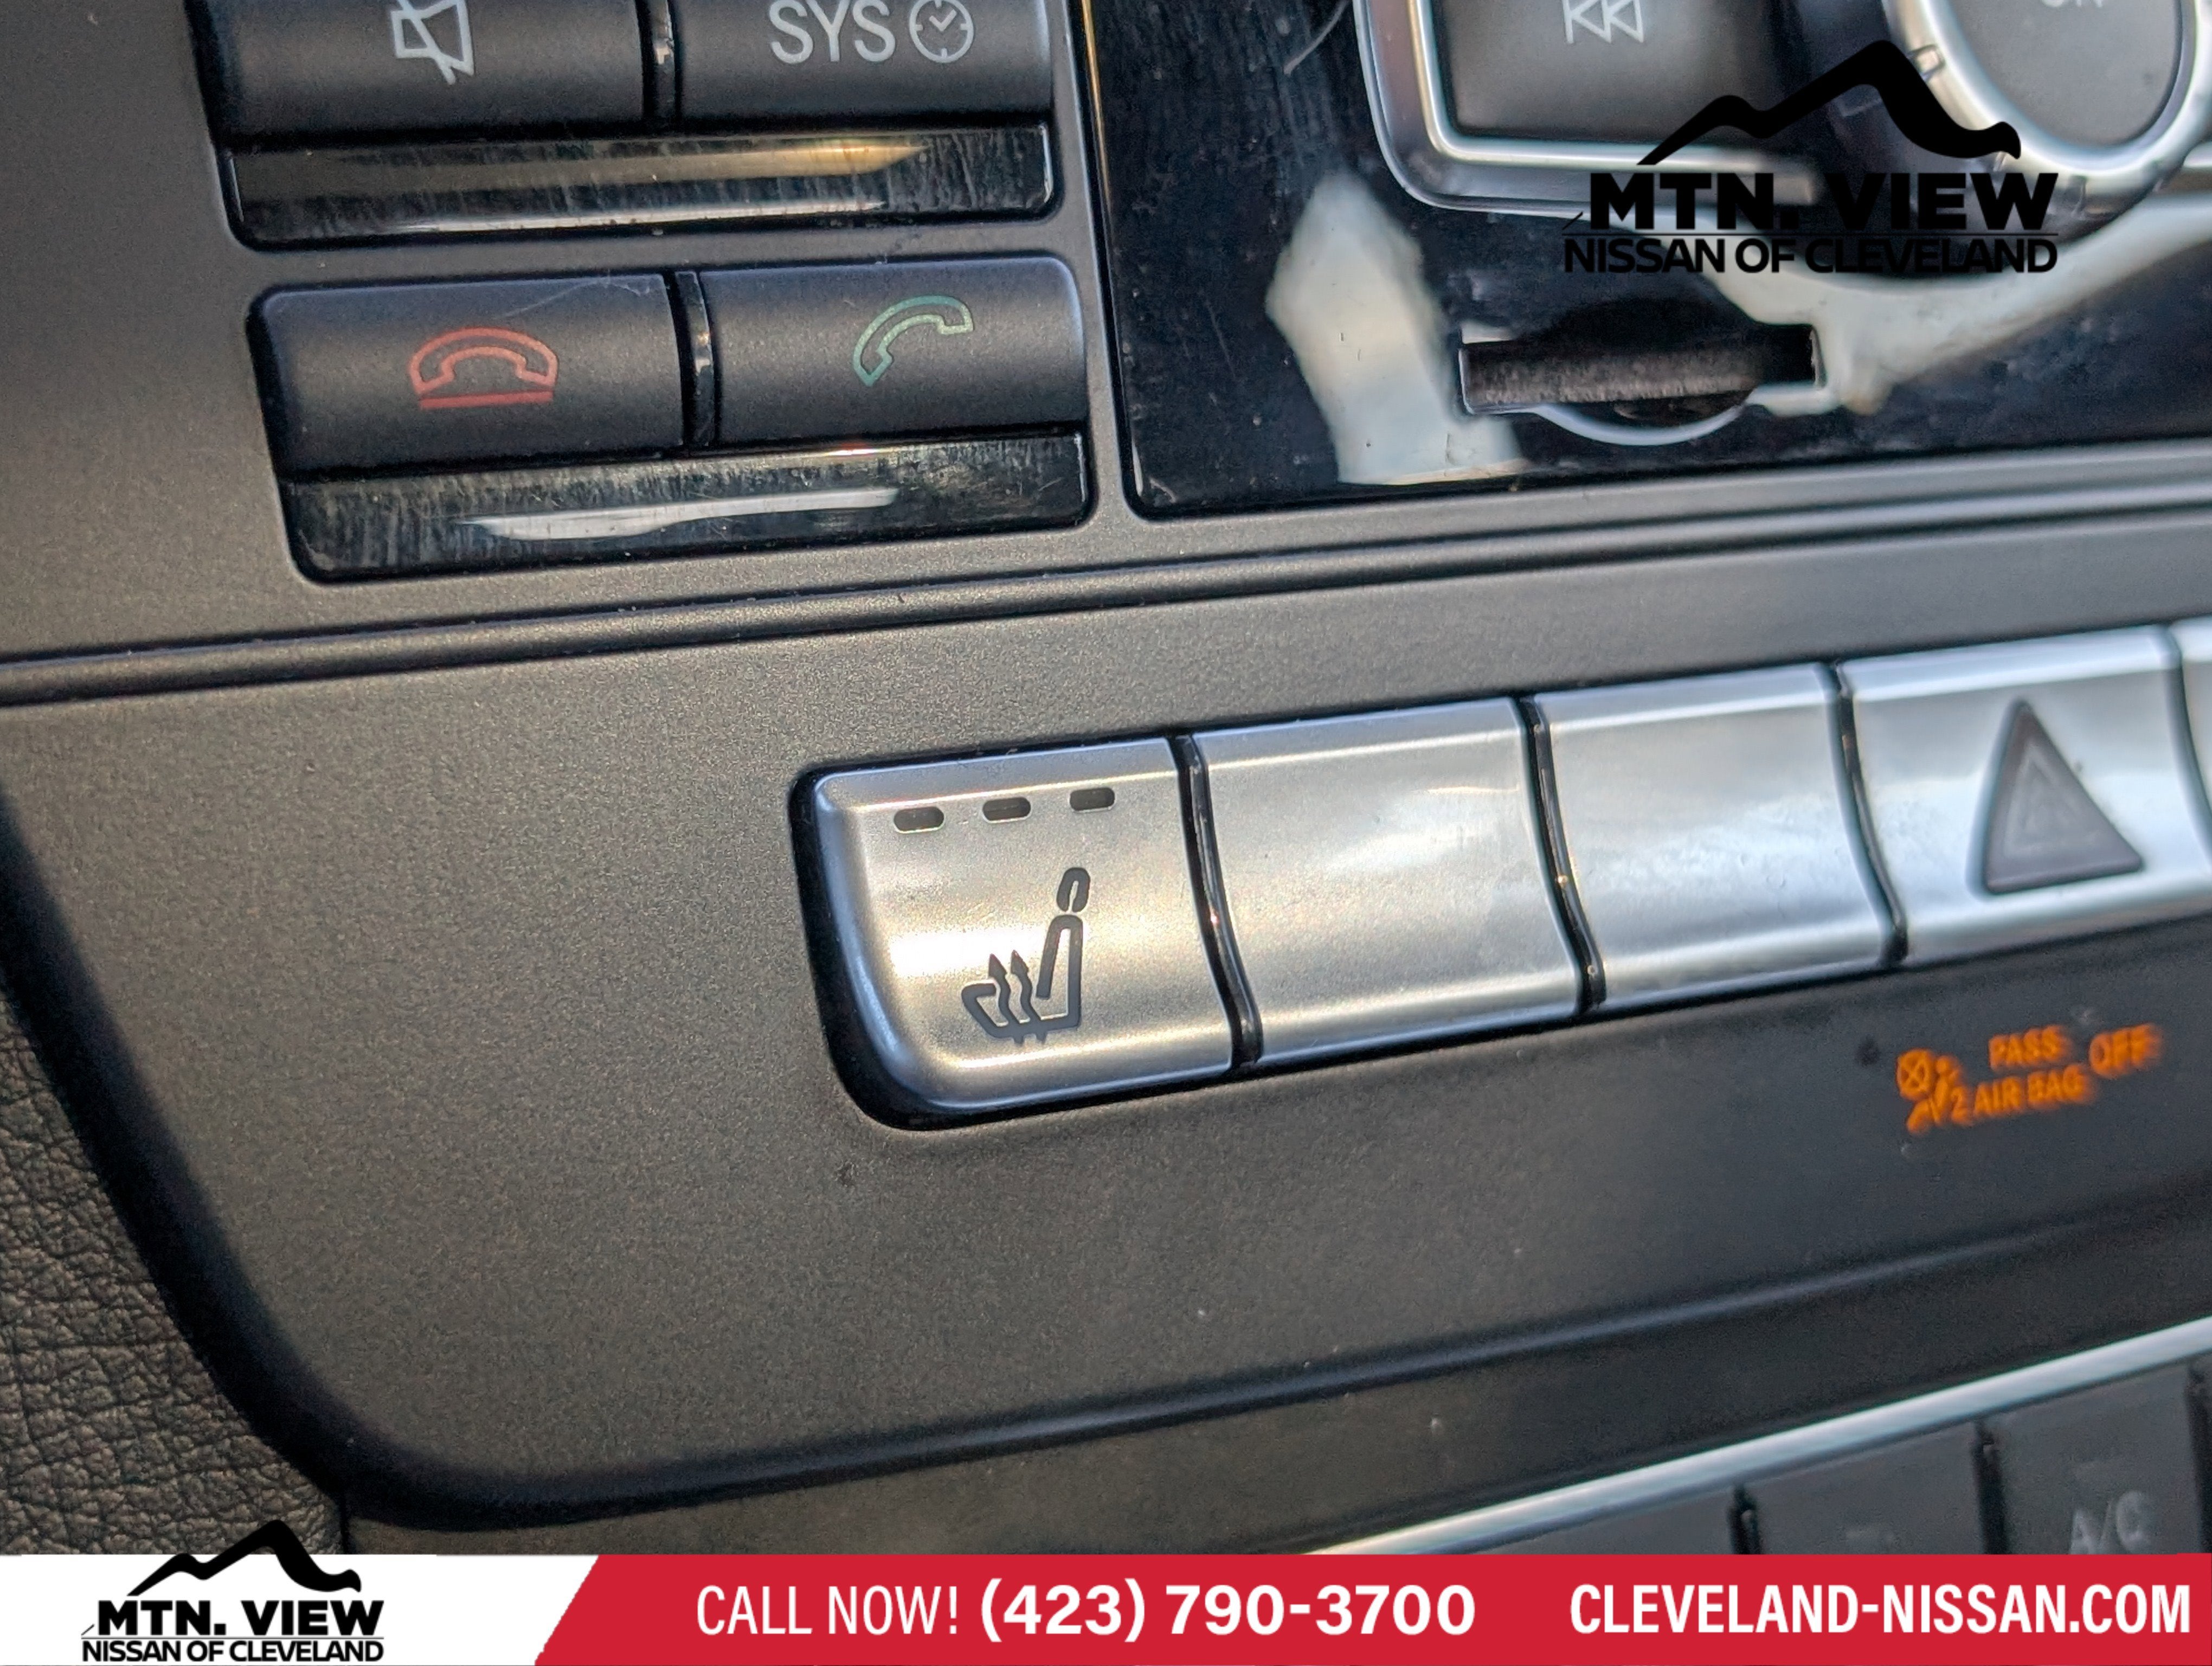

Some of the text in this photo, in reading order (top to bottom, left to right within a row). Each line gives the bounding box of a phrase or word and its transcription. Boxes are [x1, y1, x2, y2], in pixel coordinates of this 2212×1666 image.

[768, 0, 896, 63] SYS
[1988, 1026, 2074, 1071] PASS
[2089, 1023, 2160, 1078] OFF
[1973, 1064, 2095, 1117] AIR BAG
[2069, 1490, 2150, 1555] A/C
